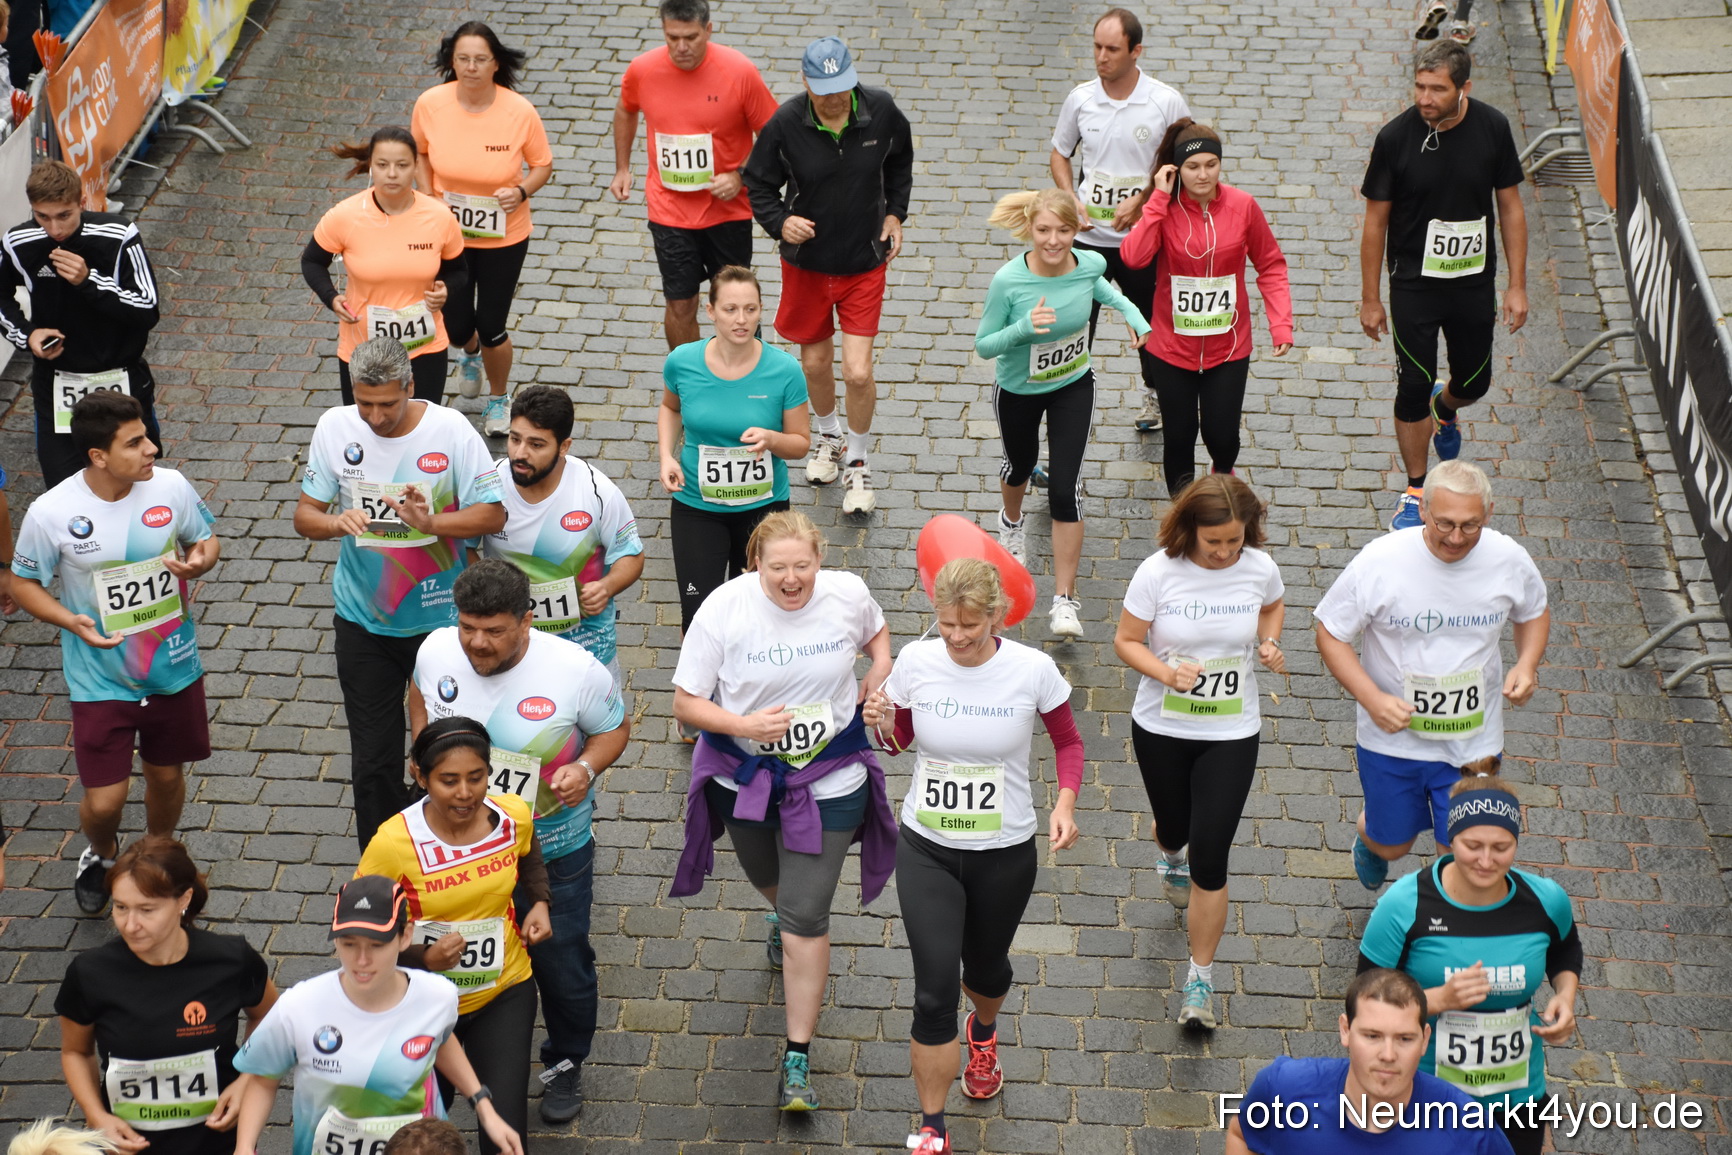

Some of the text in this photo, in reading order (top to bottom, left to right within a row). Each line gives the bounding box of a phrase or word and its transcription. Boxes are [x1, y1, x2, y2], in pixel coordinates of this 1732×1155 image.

[662, 148, 708, 169] 5110
[673, 174, 695, 183] David
[450, 205, 498, 231] 5021
[407, 243, 433, 251] THULE
[1433, 233, 1482, 257] 5073
[1439, 261, 1472, 270] Andreas
[1178, 290, 1231, 313] 5074
[375, 316, 428, 341] 5041
[1184, 318, 1222, 327] Charlotte
[1037, 335, 1084, 370] 5025
[1046, 364, 1077, 379] Barbara
[422, 458, 447, 468] Hervis
[343, 468, 365, 476] PARTL
[707, 459, 766, 483] 5175
[716, 488, 758, 499] Christine
[145, 510, 171, 523] Hervis
[565, 515, 589, 527] Hervis
[73, 541, 100, 550] PARTL
[132, 557, 164, 576] BOC
[107, 570, 173, 611] 5212
[421, 579, 440, 592] 17.
[530, 595, 569, 618] 211
[1166, 604, 1254, 615] FeG NEUMARKT
[133, 609, 158, 623] Nour
[1390, 610, 1504, 628] FeG NEUMARKT
[167, 633, 184, 648] 17.
[747, 640, 844, 664] FeG NEUMARKT
[1177, 670, 1239, 697] 279
[1413, 685, 1479, 715] 5278
[523, 702, 552, 715] Hervis
[962, 705, 1014, 718] NEUMARKT
[1190, 703, 1218, 713] Irene
[1423, 720, 1472, 731] Christian
[953, 765, 996, 776] BOCK
[487, 765, 531, 797] 47
[925, 778, 996, 811] 5012
[940, 817, 977, 829] Esther
[424, 851, 517, 894] MAX BÖGL
[458, 921, 497, 935] BOCK
[1428, 924, 1448, 932] erima
[1447, 1030, 1524, 1065] 5159
[313, 1057, 340, 1067] PARTL
[1465, 1072, 1506, 1085] Regina
[120, 1072, 208, 1100] 5114
[139, 1107, 190, 1119] Claudia
[325, 1131, 387, 1155] 516
